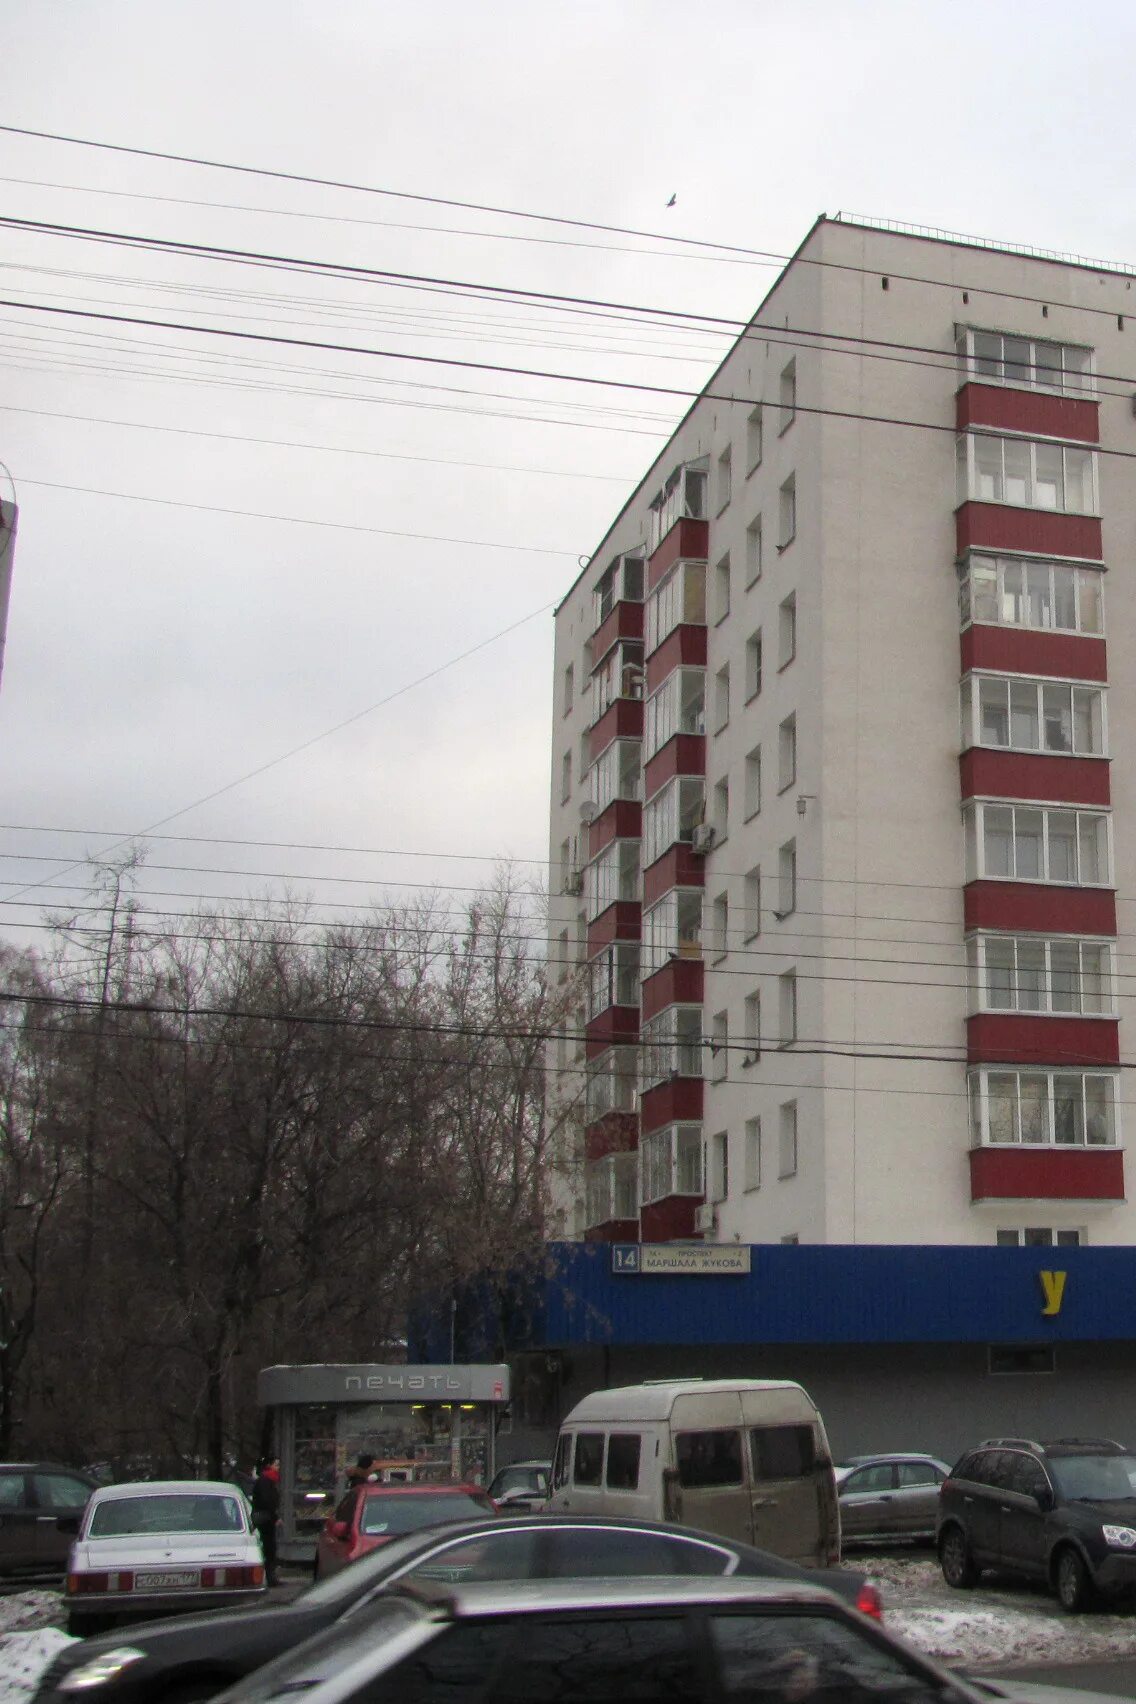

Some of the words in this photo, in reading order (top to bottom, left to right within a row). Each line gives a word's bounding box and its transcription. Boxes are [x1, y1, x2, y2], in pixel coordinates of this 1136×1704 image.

[616, 1250, 637, 1268] 14
[647, 1258, 697, 1269] МАРШАЛА
[701, 1258, 743, 1268] ЖУКОВА
